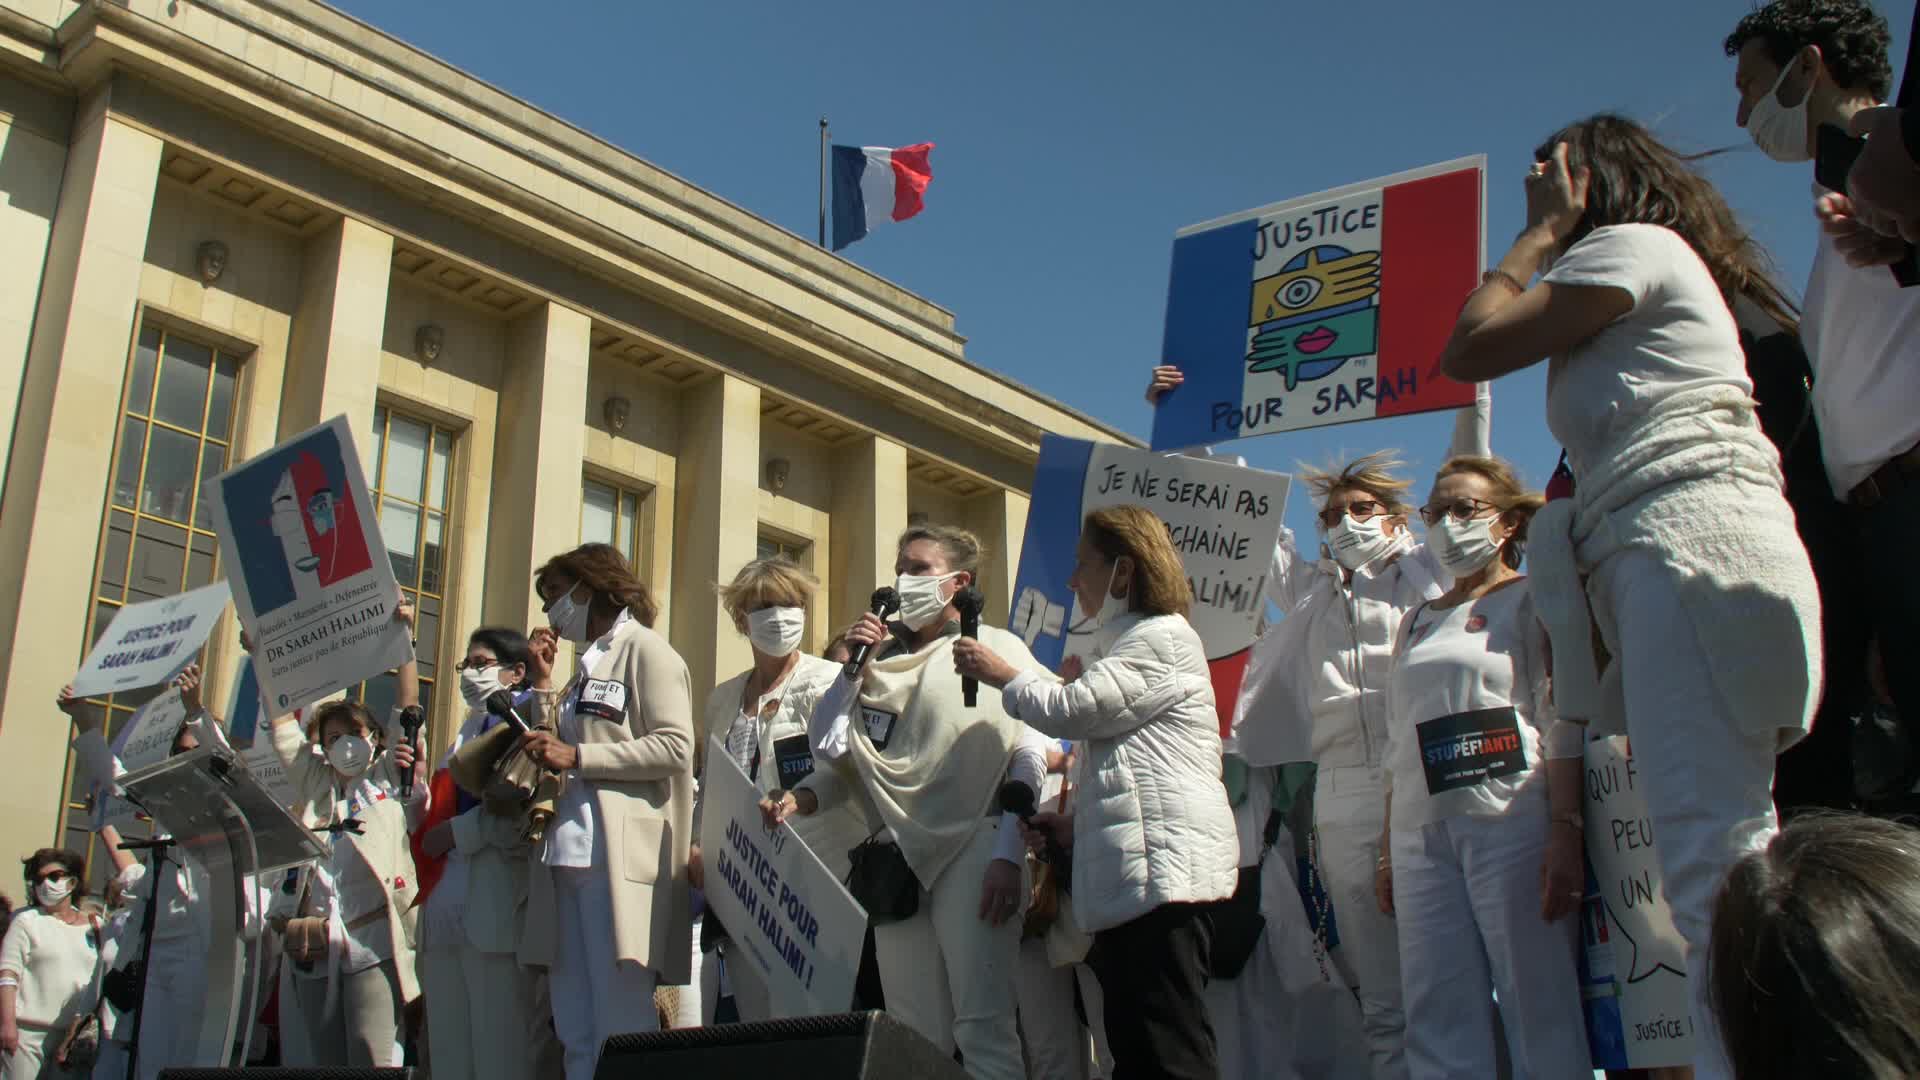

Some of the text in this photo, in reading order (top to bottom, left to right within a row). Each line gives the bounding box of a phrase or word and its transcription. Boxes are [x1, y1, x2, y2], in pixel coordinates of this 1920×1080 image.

[1211, 367, 1417, 433] POUR SARAH
[1098, 464, 1126, 495] JE
[1132, 468, 1160, 499] NE
[1235, 489, 1270, 519] PAS
[285, 626, 328, 654] SARAH
[330, 603, 385, 633] HALIMI
[609, 684, 620, 694] ET
[783, 758, 813, 774] STUP
[726, 817, 778, 898] JUSTICE
[779, 881, 819, 948] POUR
[718, 848, 758, 918] SARAH
[758, 904, 806, 979] HALIMI
